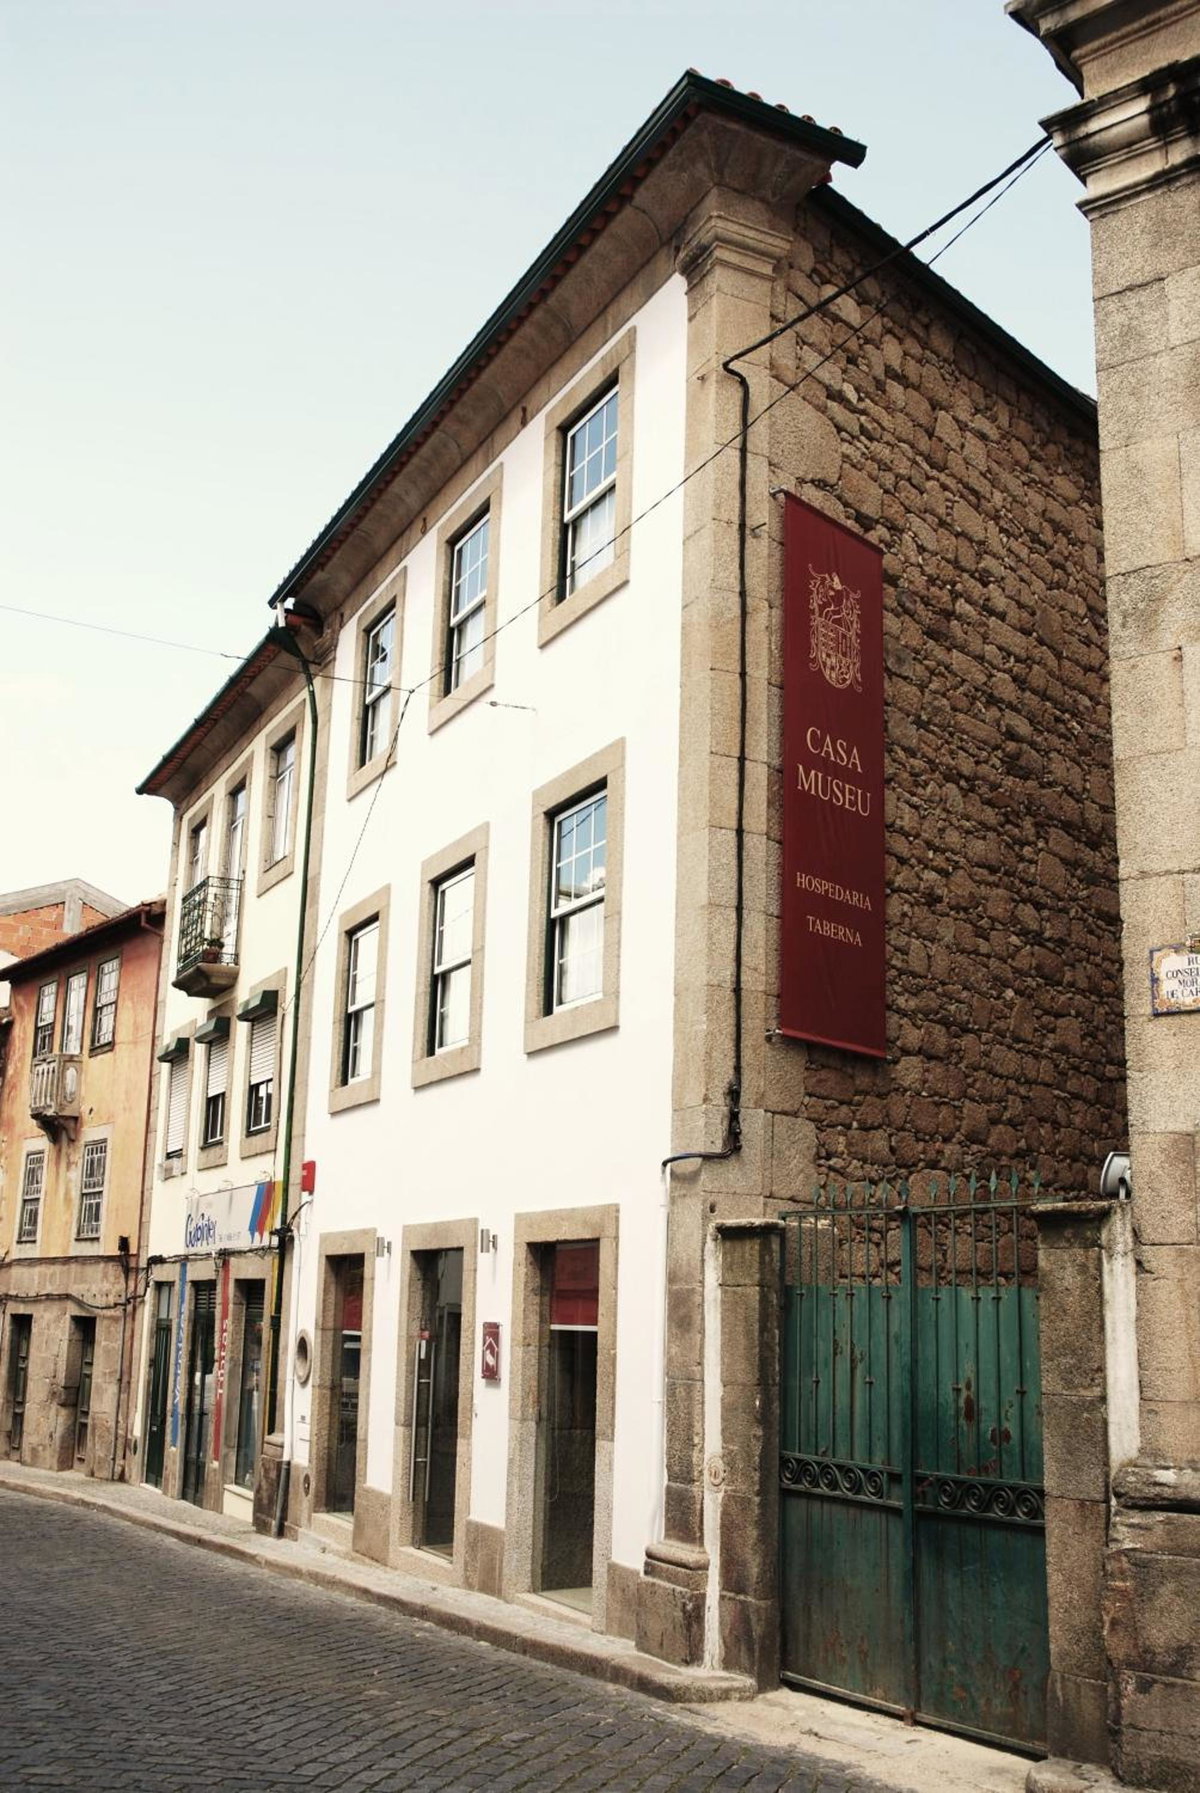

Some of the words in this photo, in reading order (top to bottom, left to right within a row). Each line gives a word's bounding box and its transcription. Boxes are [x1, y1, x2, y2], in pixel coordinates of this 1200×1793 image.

[806, 727, 863, 773] CASA
[797, 763, 871, 816] MUSEU
[796, 872, 872, 911] HOSPEDARIA
[806, 915, 862, 947] TABERNA
[216, 1319, 228, 1400] Tintas
